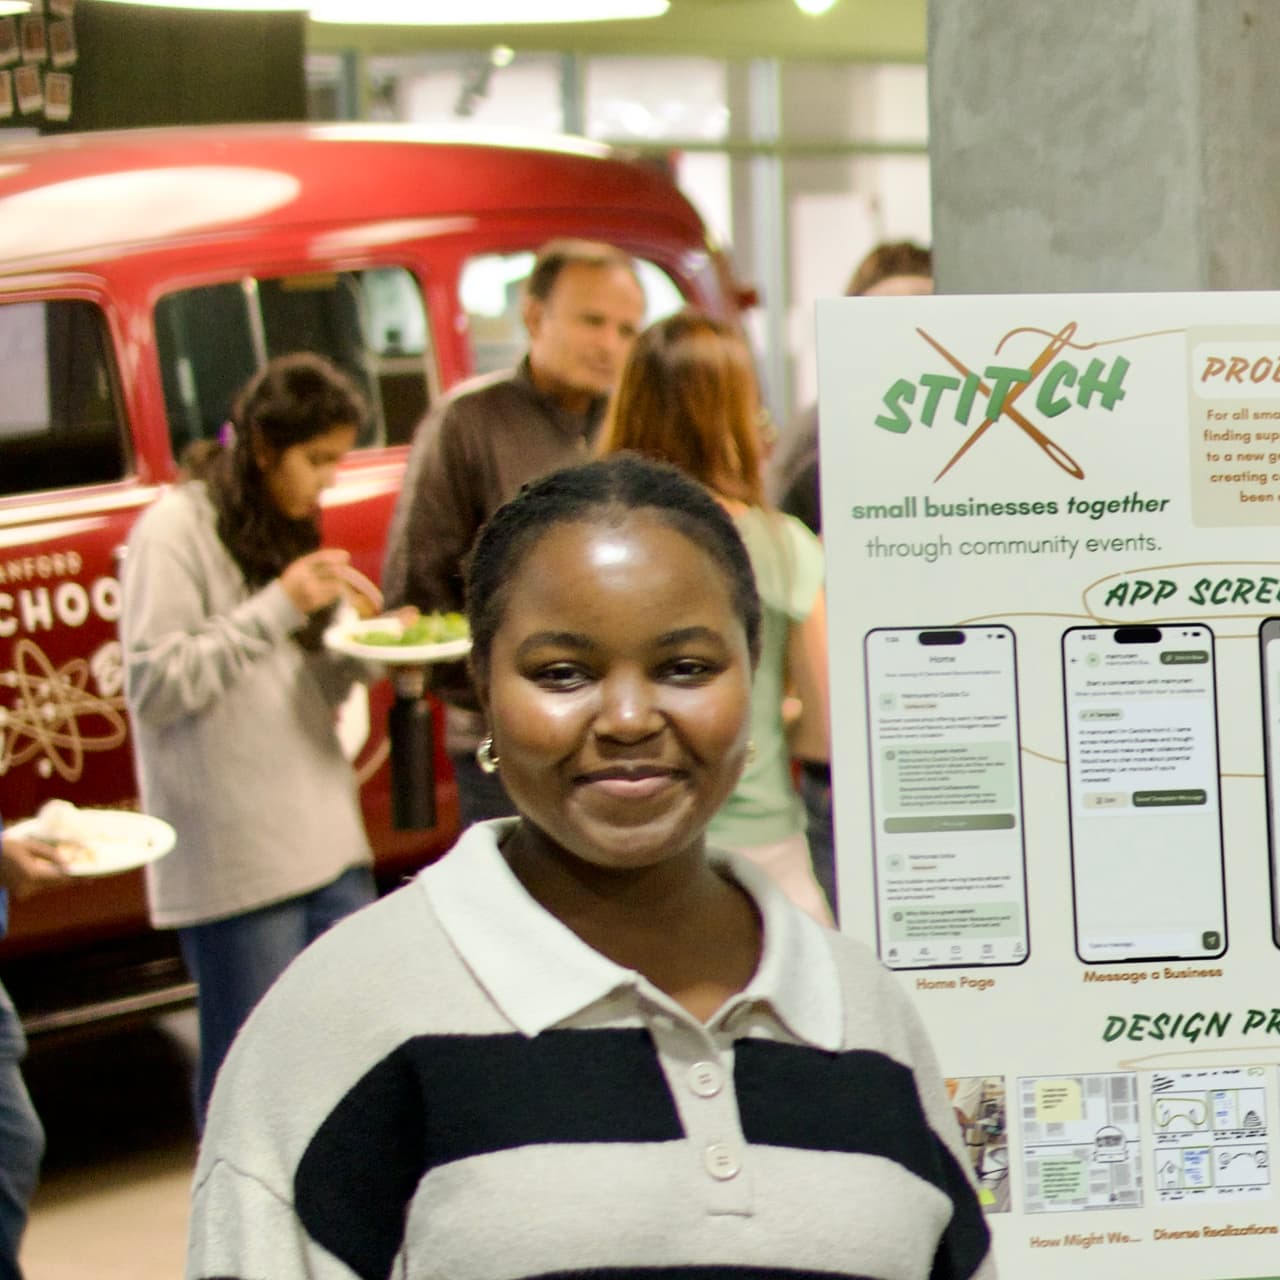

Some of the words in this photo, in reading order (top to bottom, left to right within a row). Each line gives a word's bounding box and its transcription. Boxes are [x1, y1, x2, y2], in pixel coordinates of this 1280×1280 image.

[874, 355, 1130, 434] STITCH
[1206, 409, 1228, 420] For
[1232, 408, 1249, 420] all
[1203, 429, 1251, 444] finding
[1206, 451, 1220, 462] to
[1224, 453, 1232, 461] a
[1237, 453, 1264, 461] new
[1210, 471, 1268, 485] creating
[1239, 490, 1274, 502] been
[851, 497, 917, 519] small
[924, 496, 1059, 518] businesses
[1067, 492, 1170, 519] together
[865, 535, 952, 562] through
[959, 533, 1079, 559] community
[1085, 533, 1163, 555] events.
[1104, 580, 1178, 608] APP
[916, 978, 956, 990] Home
[959, 976, 995, 991] Page
[1083, 970, 1147, 984] Message
[1163, 967, 1223, 980] Business
[1102, 1012, 1232, 1043] DESIGN
[1153, 1228, 1200, 1241] Diverse
[1203, 1224, 1279, 1237] Realizations
[1030, 1236, 1060, 1248] How
[1064, 1233, 1104, 1249] Might
